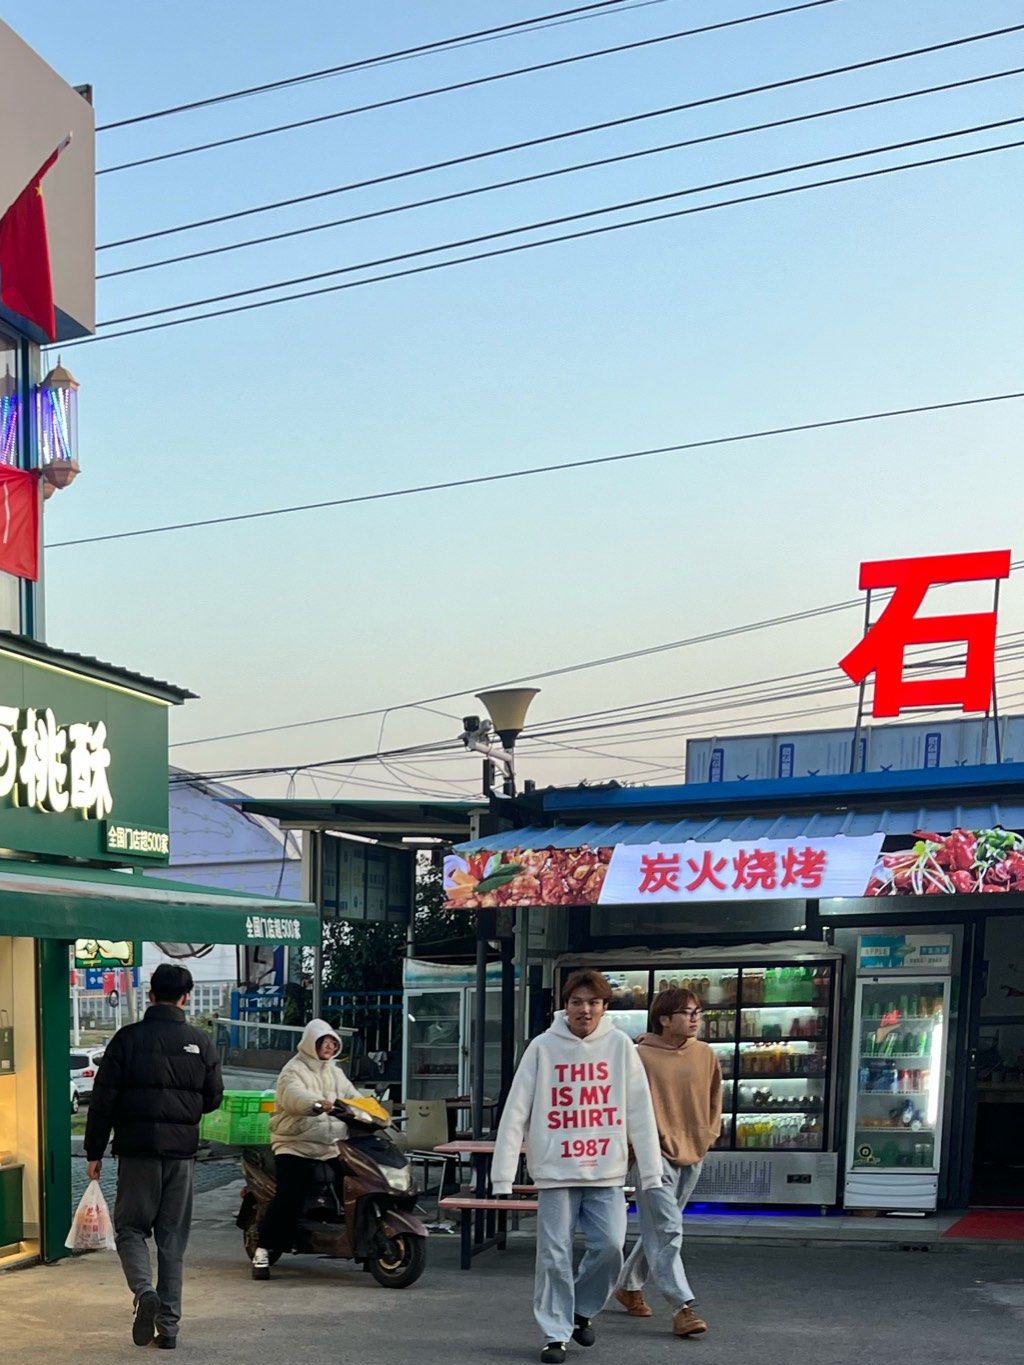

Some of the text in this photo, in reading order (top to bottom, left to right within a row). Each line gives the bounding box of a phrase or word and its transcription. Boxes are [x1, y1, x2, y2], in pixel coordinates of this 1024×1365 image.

[839, 549, 1012, 718] 石
[107, 825, 170, 855] 全国门店超500家
[638, 846, 827, 894] 炭火烧烤
[245, 915, 302, 941] 全国门店超500家
[554, 1062, 609, 1082] THIS
[551, 1085, 612, 1107] IS MY
[547, 1106, 623, 1130] SHIRT.
[560, 1138, 611, 1158] 1987
